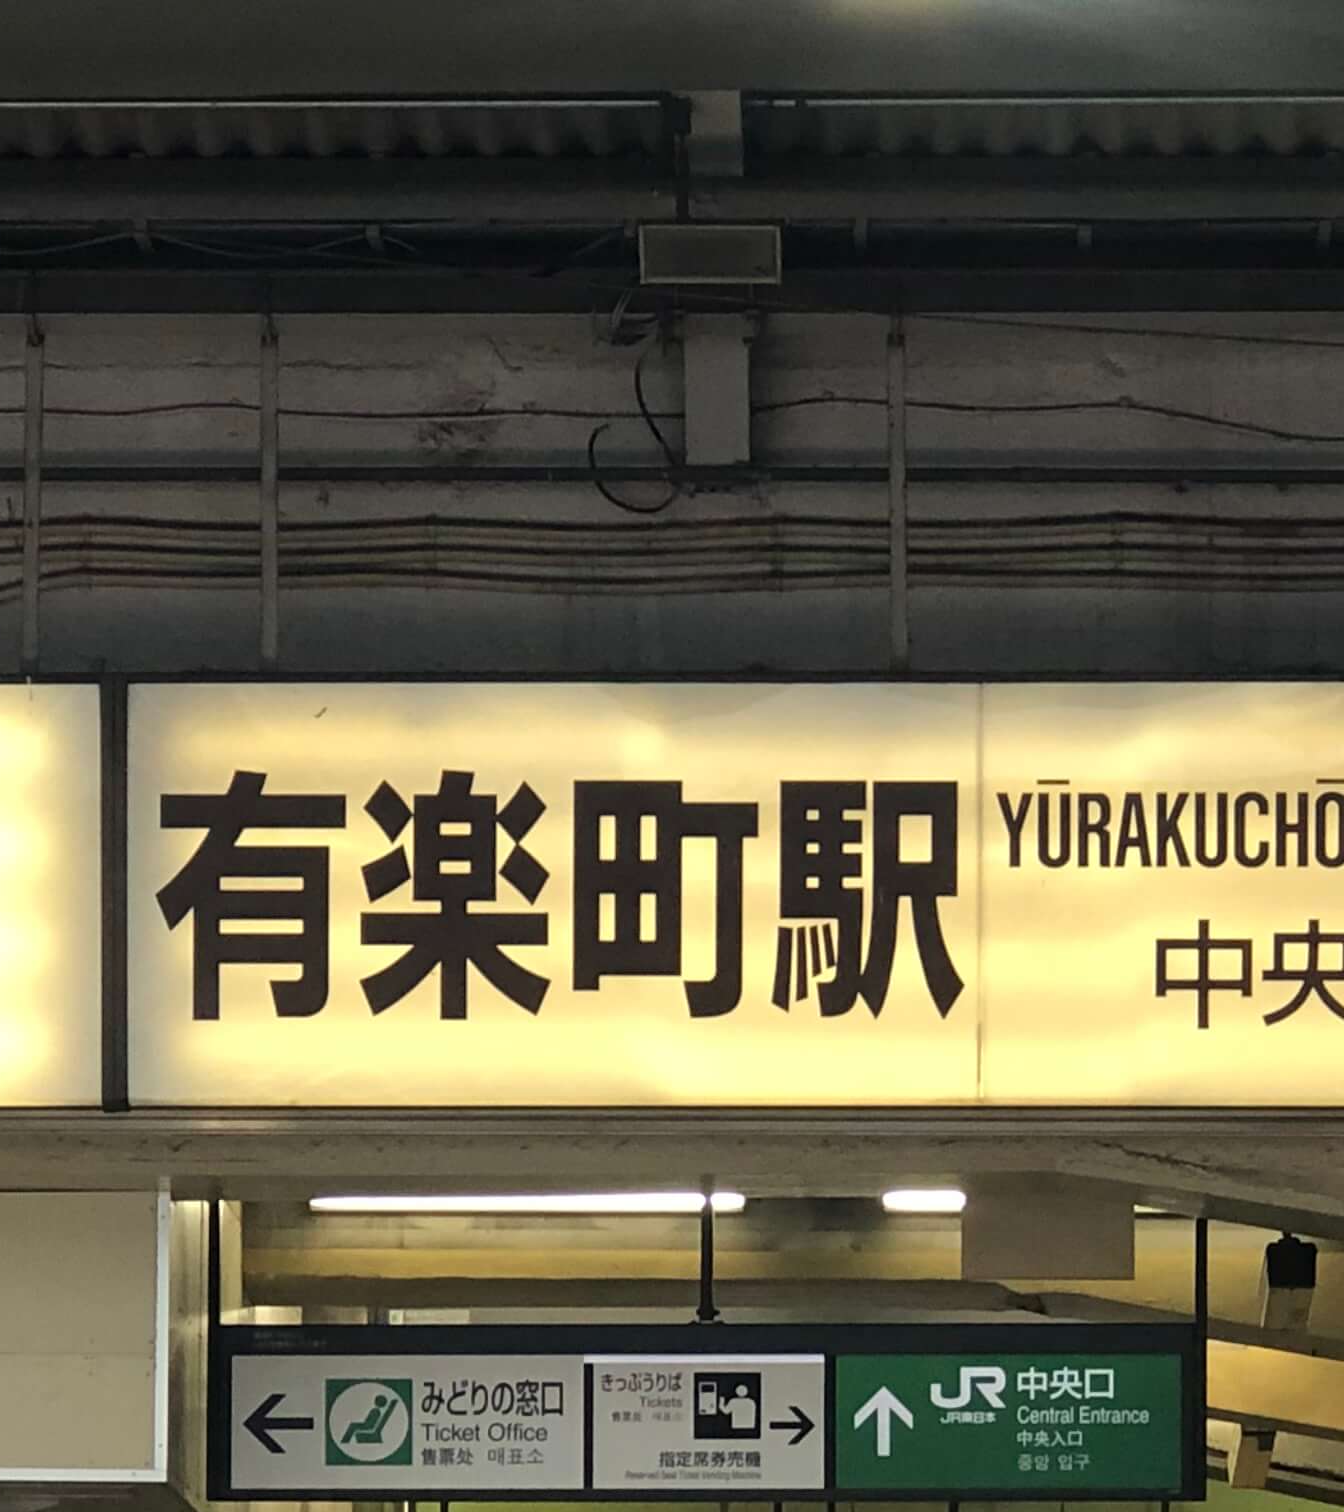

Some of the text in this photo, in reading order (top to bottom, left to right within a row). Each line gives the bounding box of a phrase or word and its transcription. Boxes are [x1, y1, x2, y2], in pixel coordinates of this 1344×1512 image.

[155, 769, 966, 1020] 有楽町駅
[601, 1372, 683, 1393] きっぷうりば
[929, 1366, 1007, 1409] JR
[1016, 1366, 1115, 1400] 中央口
[420, 1379, 565, 1418] みどりの窓口
[639, 1396, 683, 1409] Tickets
[1017, 1406, 1150, 1425] Central Entrance
[421, 1422, 548, 1443] Ticket Office
[1016, 1430, 1083, 1447] 中央入口
[659, 1451, 761, 1468] 指定席券売機
[1057, 1453, 1091, 1471] 입구
